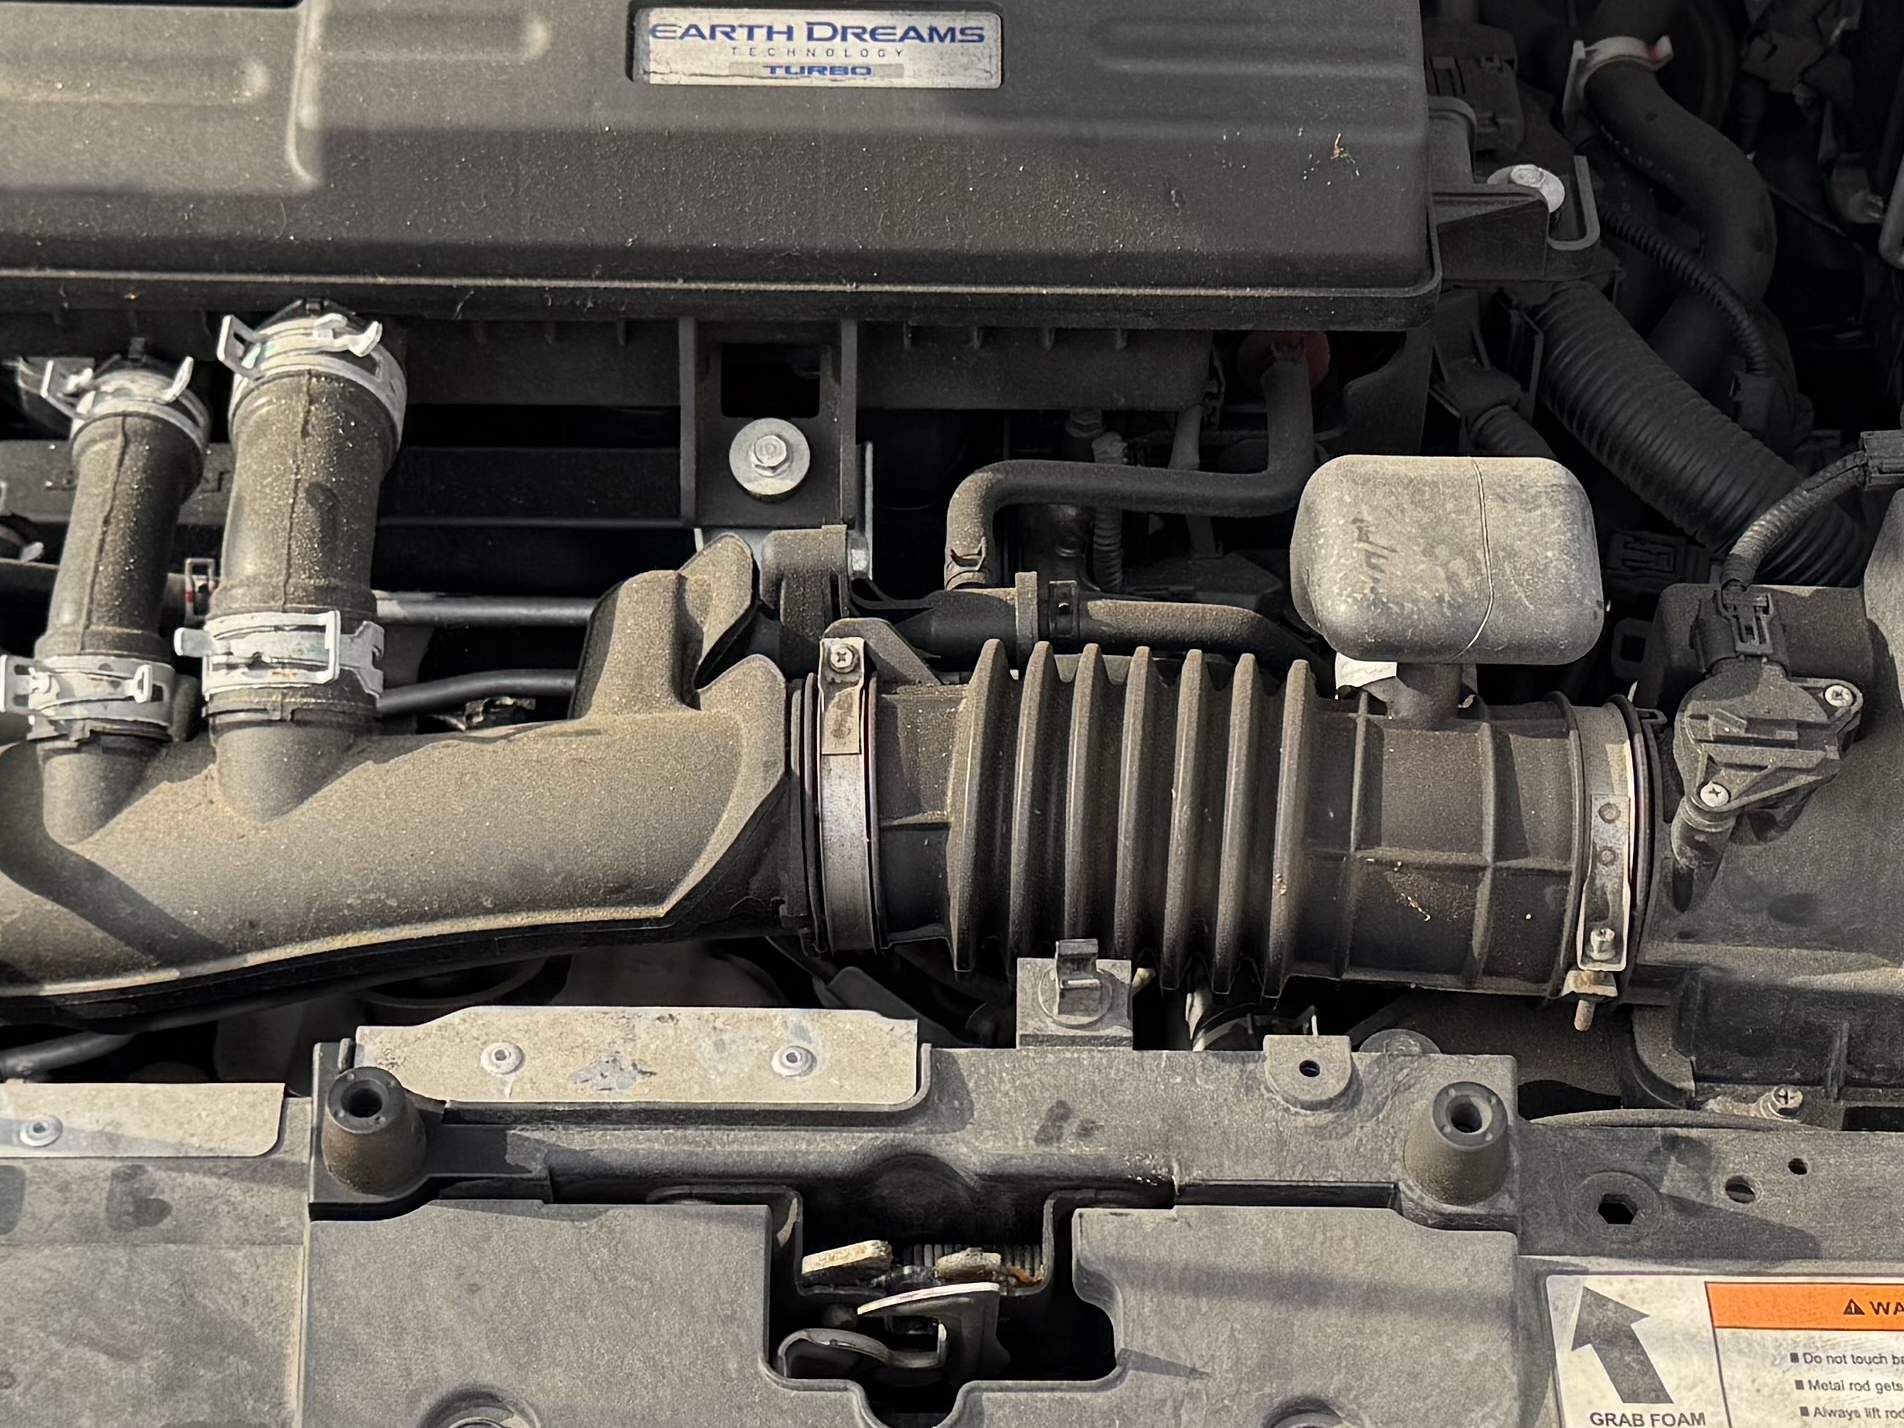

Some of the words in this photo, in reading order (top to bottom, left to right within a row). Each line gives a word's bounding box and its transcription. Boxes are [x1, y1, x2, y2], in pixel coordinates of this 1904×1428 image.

[649, 23, 795, 43] EARTH
[806, 21, 986, 44] DREAMS
[731, 46, 904, 59] TECHNOLOGY
[763, 65, 873, 77] TURBO
[1803, 1352, 1822, 1365] Do
[1826, 1353, 1847, 1365] not
[1851, 1352, 1888, 1365] touch
[1808, 1379, 1845, 1392] Metal
[1849, 1380, 1871, 1392] rod
[1876, 1381, 1904, 1395] gets
[1589, 1411, 1645, 1428] GRAB
[1650, 1411, 1706, 1428] FOAM
[1813, 1406, 1862, 1421] Always
[1864, 1407, 1881, 1420] lift
